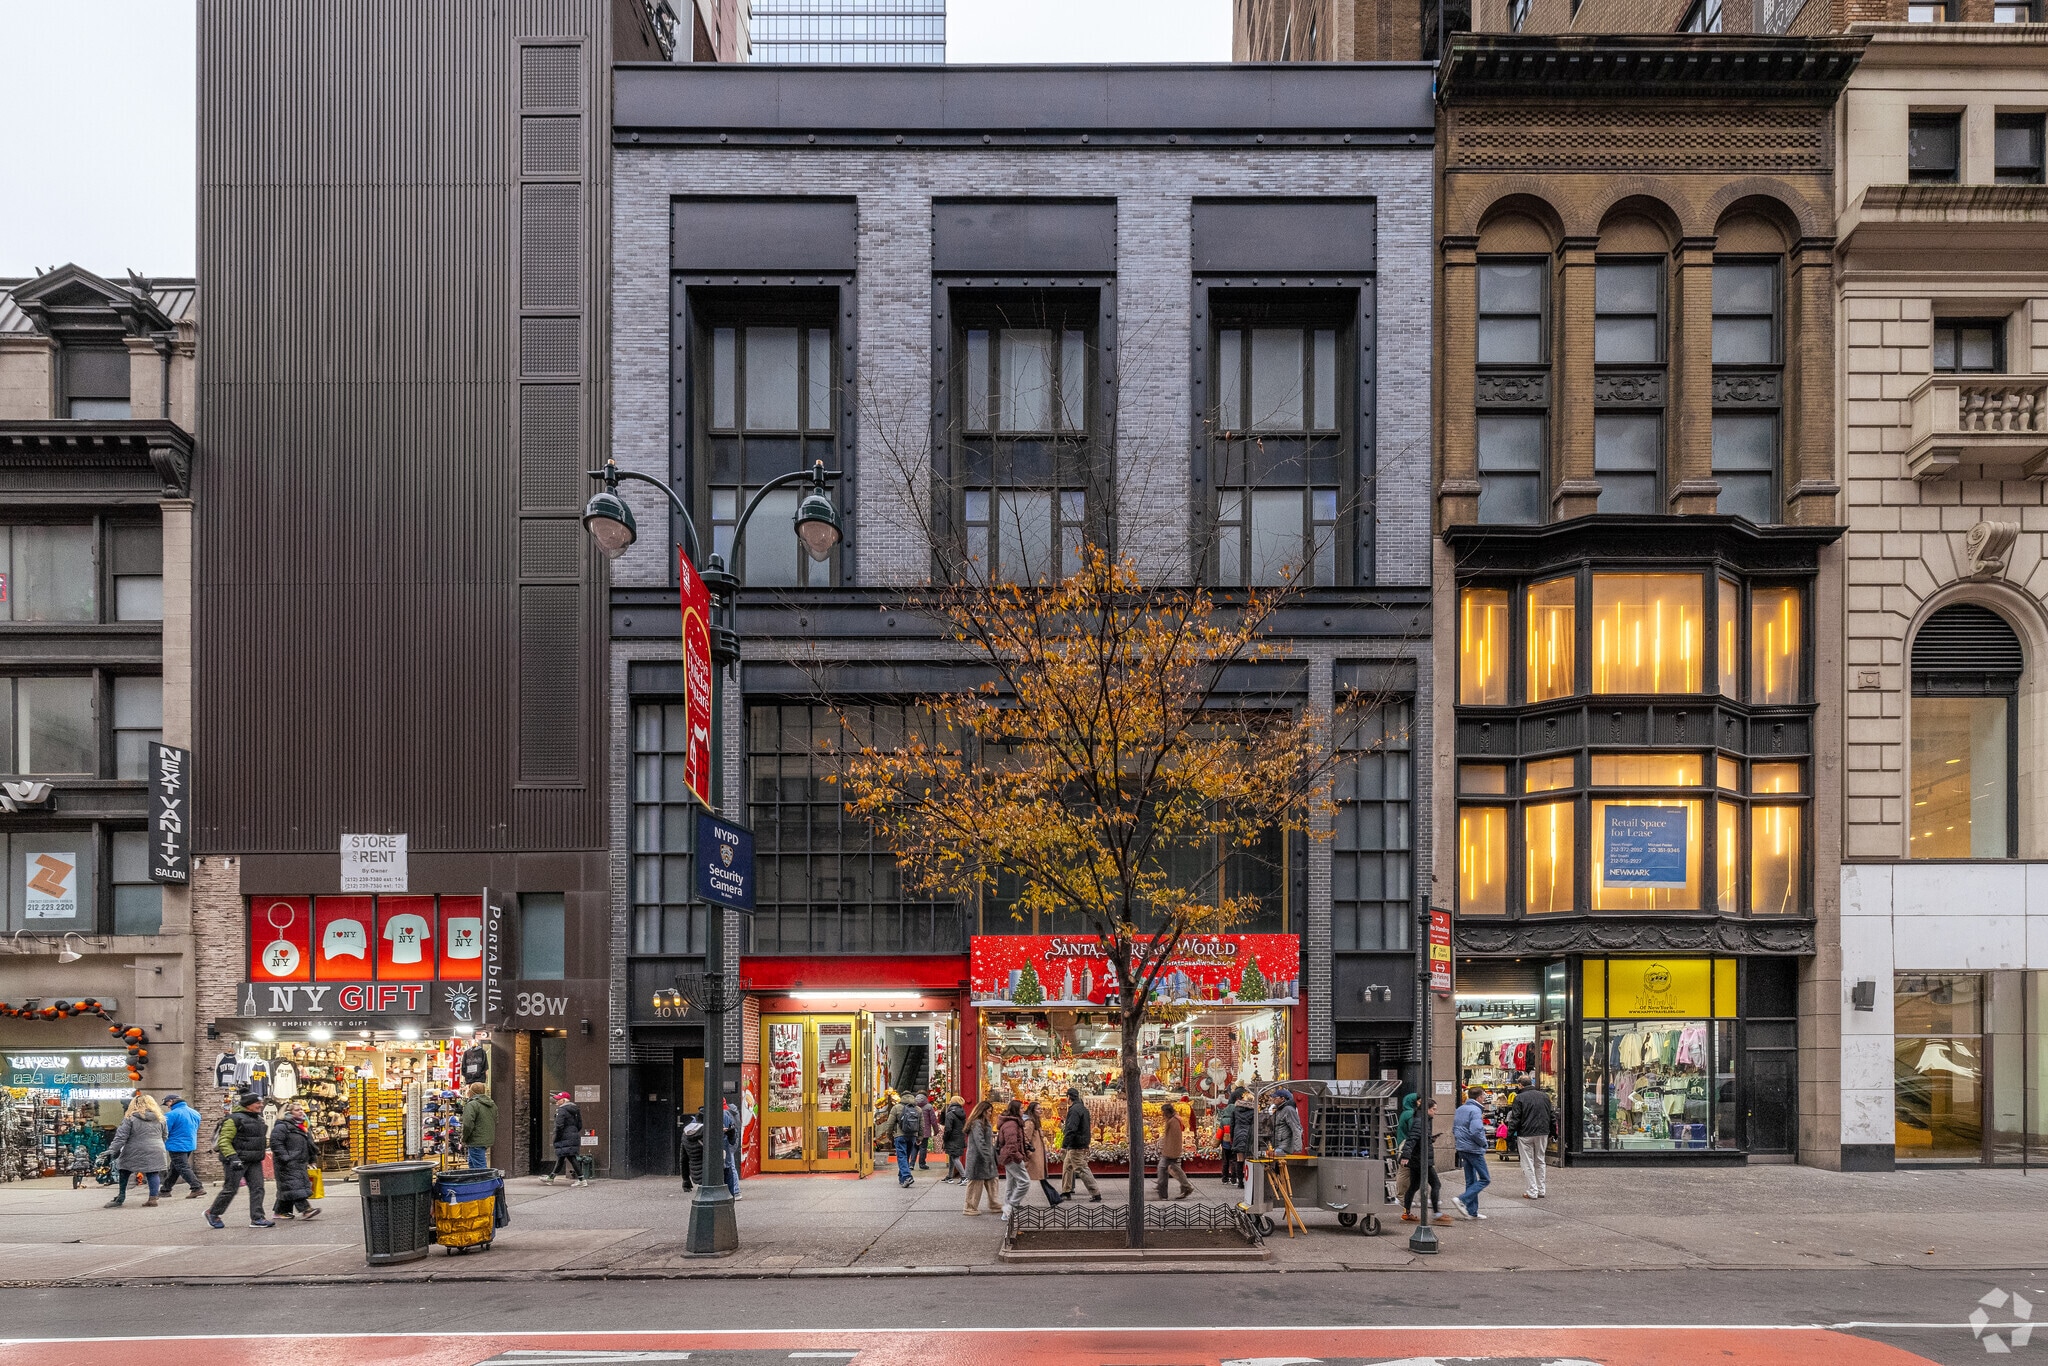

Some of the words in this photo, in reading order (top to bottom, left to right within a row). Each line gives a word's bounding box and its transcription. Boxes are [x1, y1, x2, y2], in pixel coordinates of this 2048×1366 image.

[687, 651, 710, 698] Holiday
[688, 671, 709, 712] Square
[159, 746, 182, 795] NEXT
[1611, 818, 1638, 827] Retail
[1640, 819, 1667, 829] Space
[159, 795, 182, 867] VANITY
[714, 826, 739, 845] NYPD
[1611, 828, 1625, 837] for
[1627, 828, 1653, 837] Lease
[351, 836, 396, 848] STORE
[360, 851, 396, 863] RENT
[155, 867, 186, 880] SALON
[709, 863, 744, 887] Security
[1609, 868, 1651, 876] NEWMARK
[710, 877, 743, 897] Camera
[398, 935, 415, 943] NY
[455, 938, 473, 947] NY
[1177, 938, 1236, 959] WORLD
[272, 958, 290, 967] NY
[268, 986, 331, 1013] NY
[338, 985, 423, 1012] GIFT
[654, 1007, 671, 1018] 40
[675, 1007, 690, 1018] W
[81, 1055, 127, 1068] VAPES
